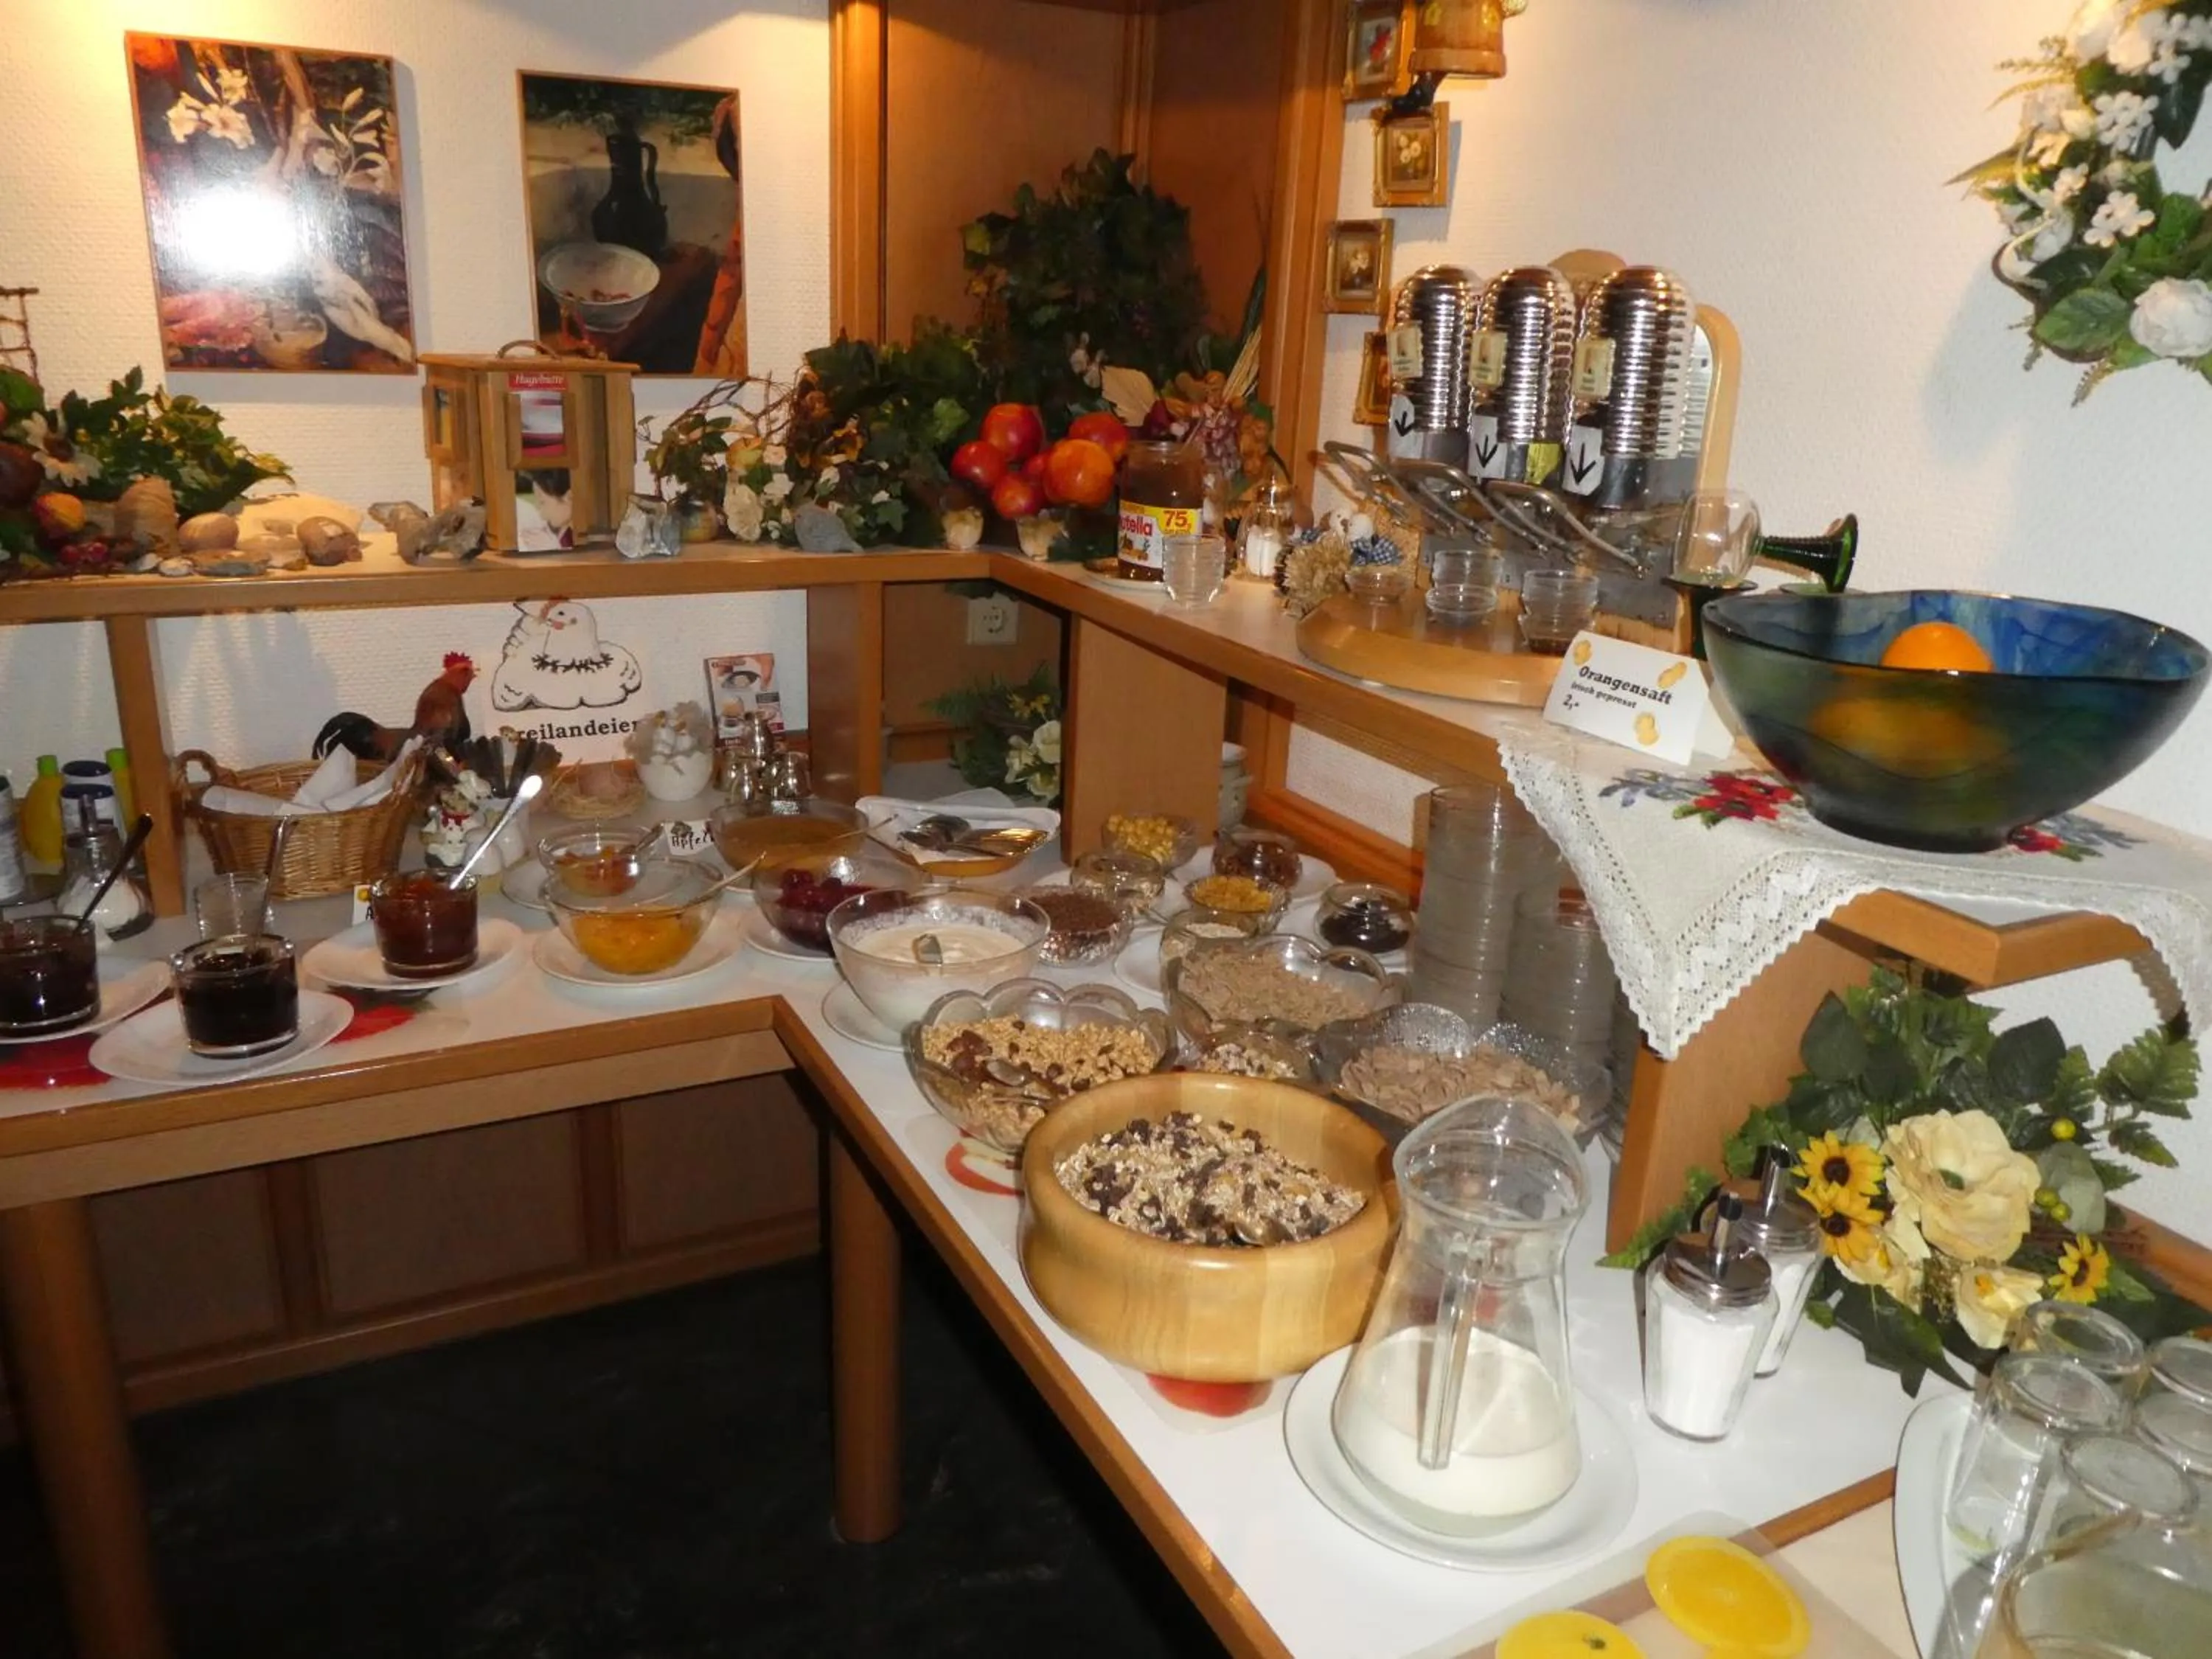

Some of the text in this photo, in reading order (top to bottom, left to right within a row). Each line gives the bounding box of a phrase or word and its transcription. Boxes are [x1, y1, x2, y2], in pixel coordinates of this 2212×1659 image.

[1119, 515, 1152, 537] utella
[1579, 666, 1672, 705] Orangensaft
[518, 717, 638, 740] reilandeier
